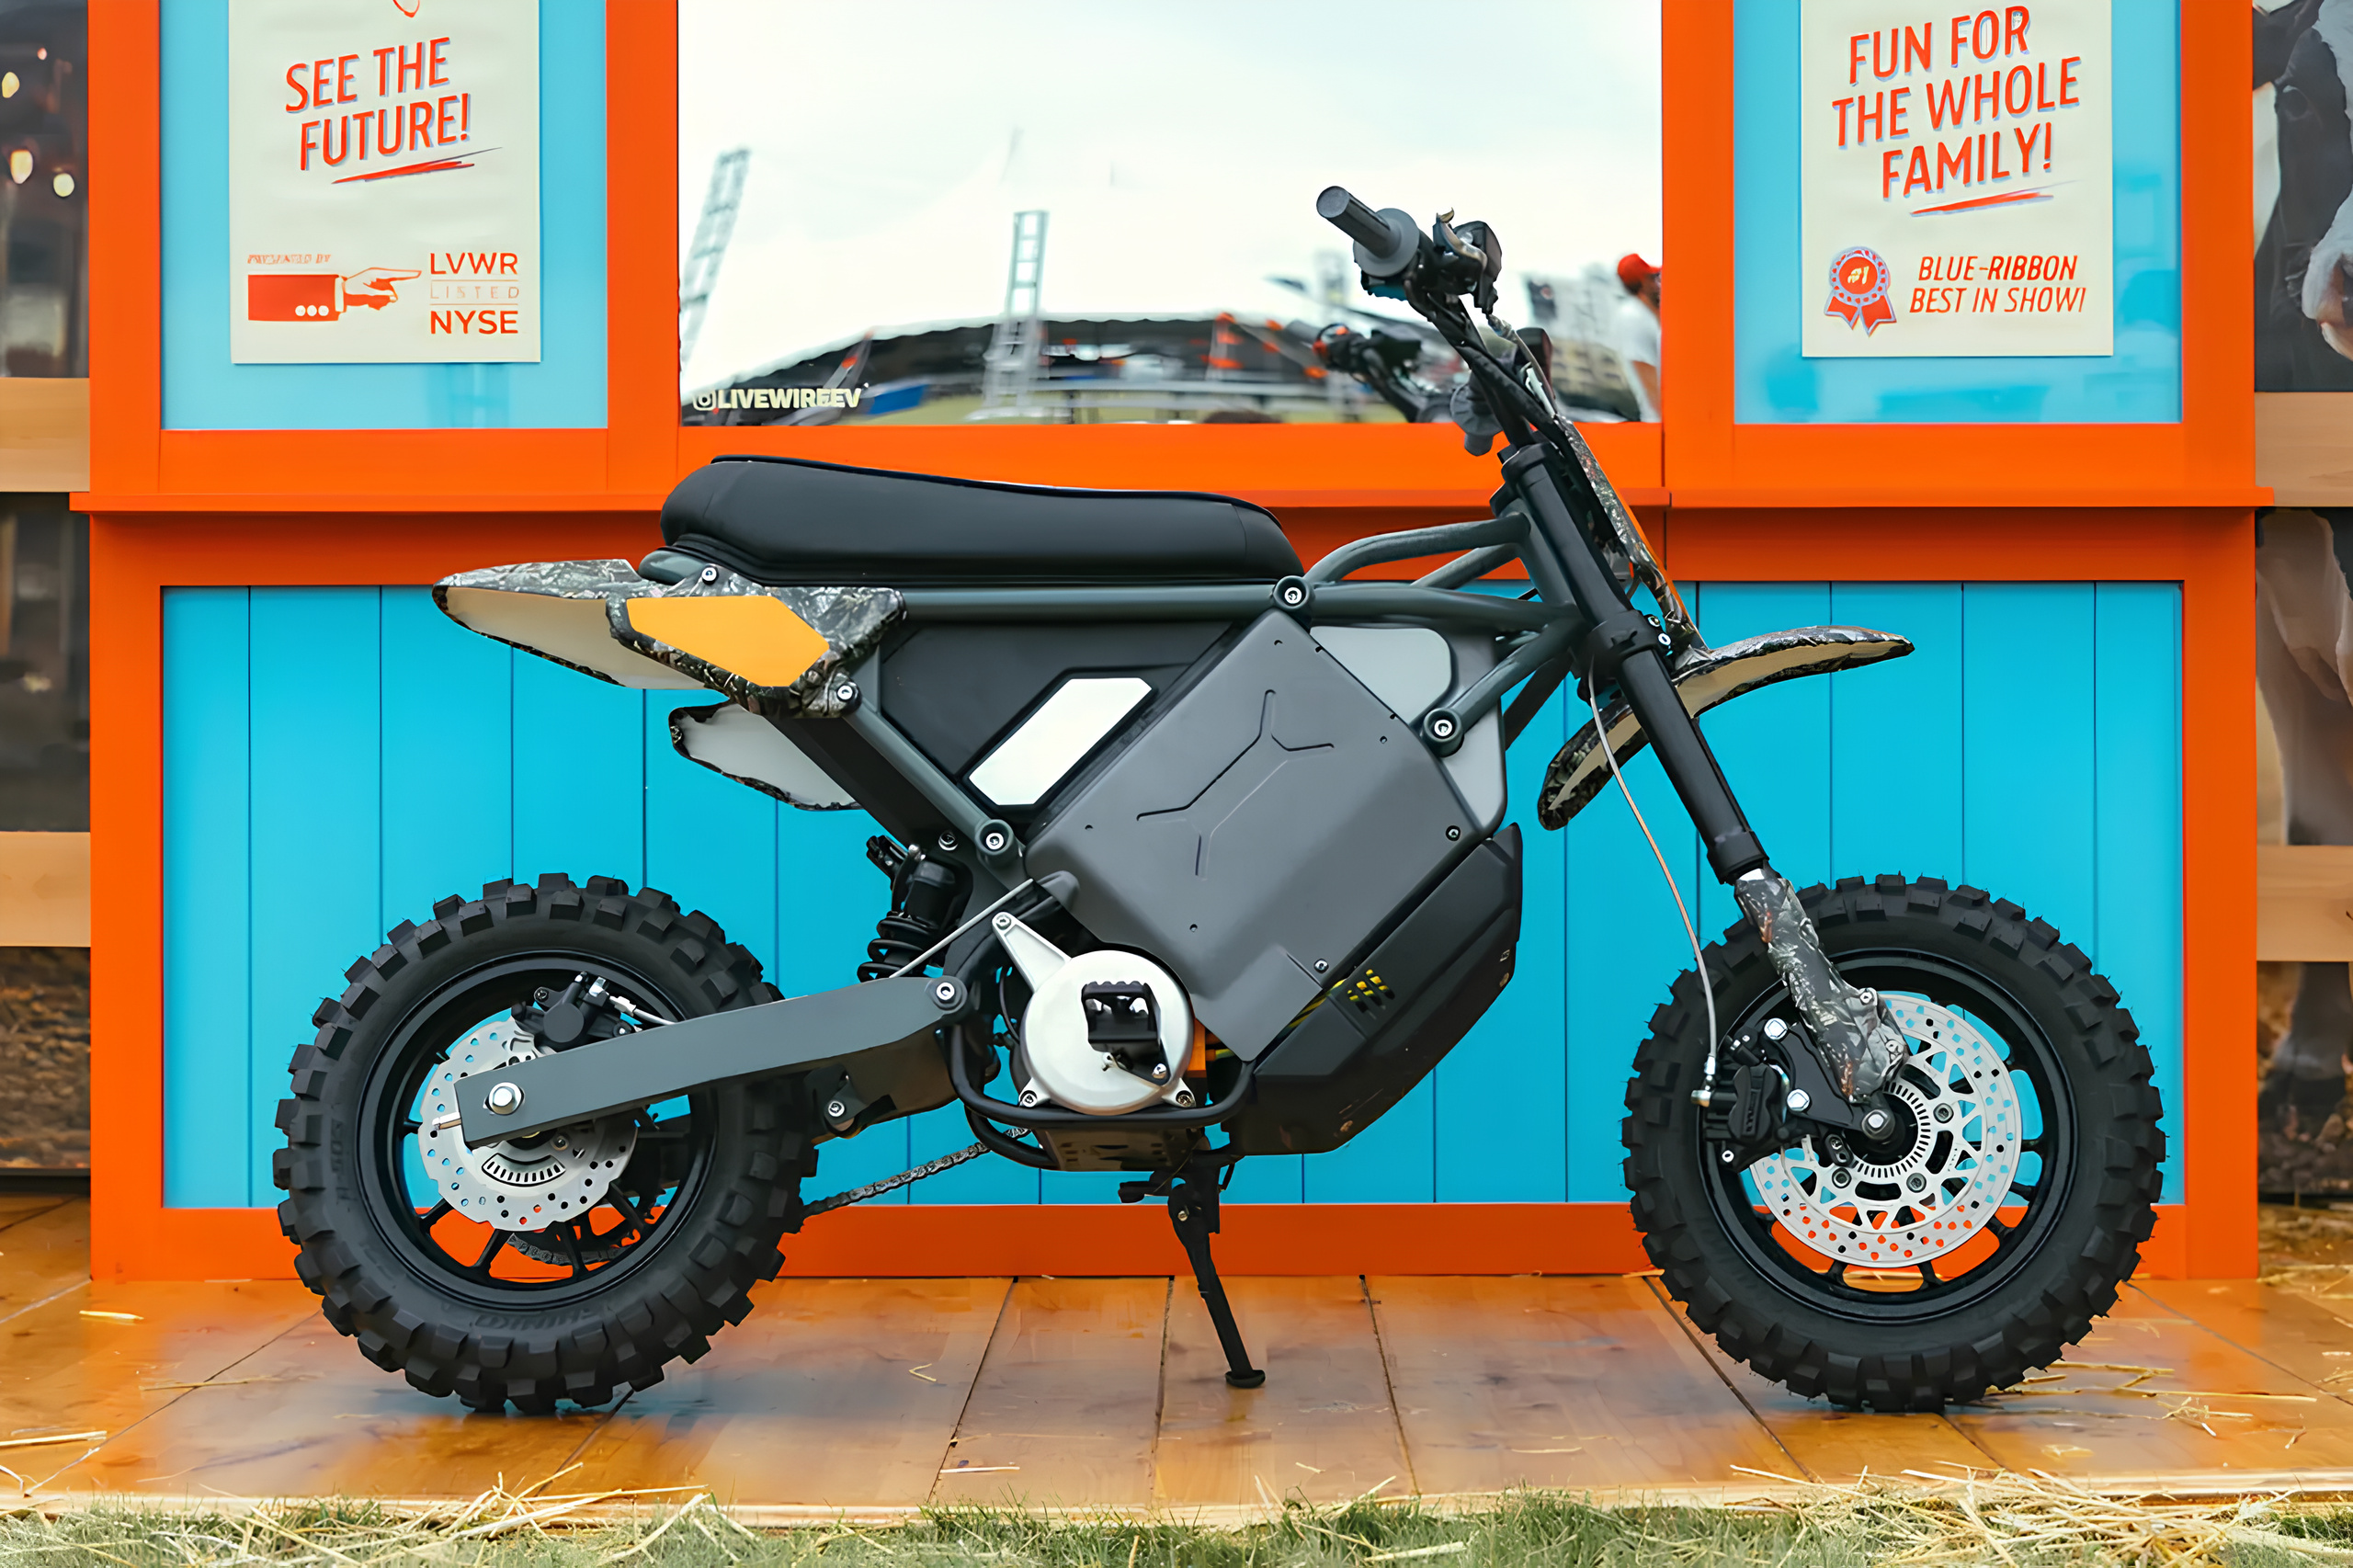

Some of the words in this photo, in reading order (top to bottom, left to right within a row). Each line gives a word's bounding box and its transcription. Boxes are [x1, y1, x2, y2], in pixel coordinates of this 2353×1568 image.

[1850, 22, 1932, 84] FUN
[1951, 6, 2029, 64] FOR
[286, 54, 358, 111] SEE
[373, 37, 449, 96] THE
[1832, 87, 1910, 146] THE
[1927, 56, 2080, 129] WHOLE
[301, 93, 468, 170] FUTURE!
[1883, 122, 2052, 198] FAMILY!
[430, 253, 517, 275] LVWR
[1919, 256, 2078, 281] BLUE-RIBBON
[430, 285, 519, 300] LISTED
[1910, 288, 1967, 313] BEST
[1972, 288, 1998, 312] IN
[430, 310, 518, 335] NYSE
